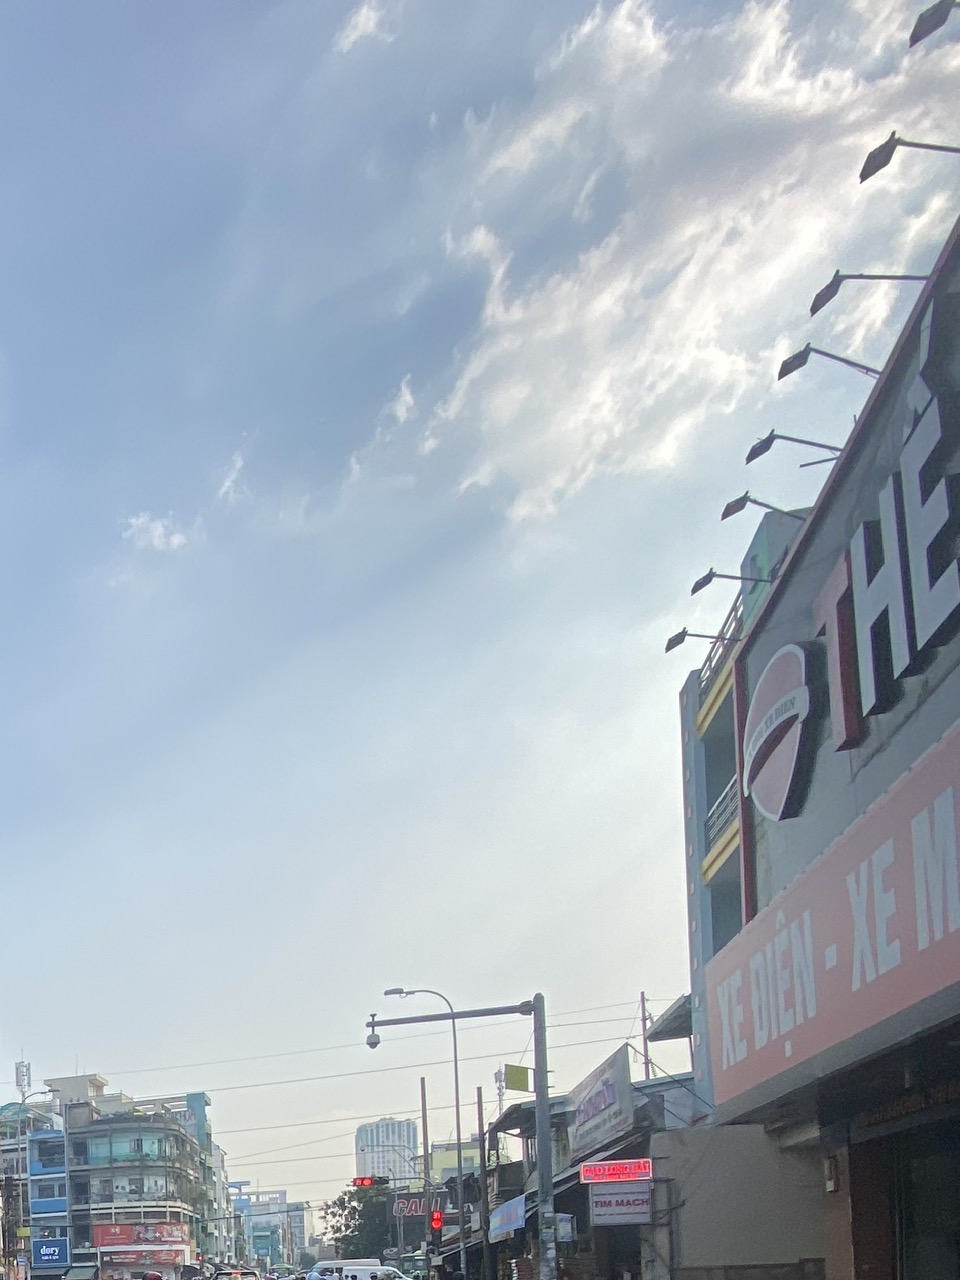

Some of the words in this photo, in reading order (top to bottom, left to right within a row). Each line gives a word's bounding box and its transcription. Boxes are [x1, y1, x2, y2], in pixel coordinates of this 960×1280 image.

[716, 968, 748, 1072] XE
[749, 908, 817, 1057] ĐIỆN
[845, 837, 902, 992] XE
[40, 1245, 61, 1256] dory
